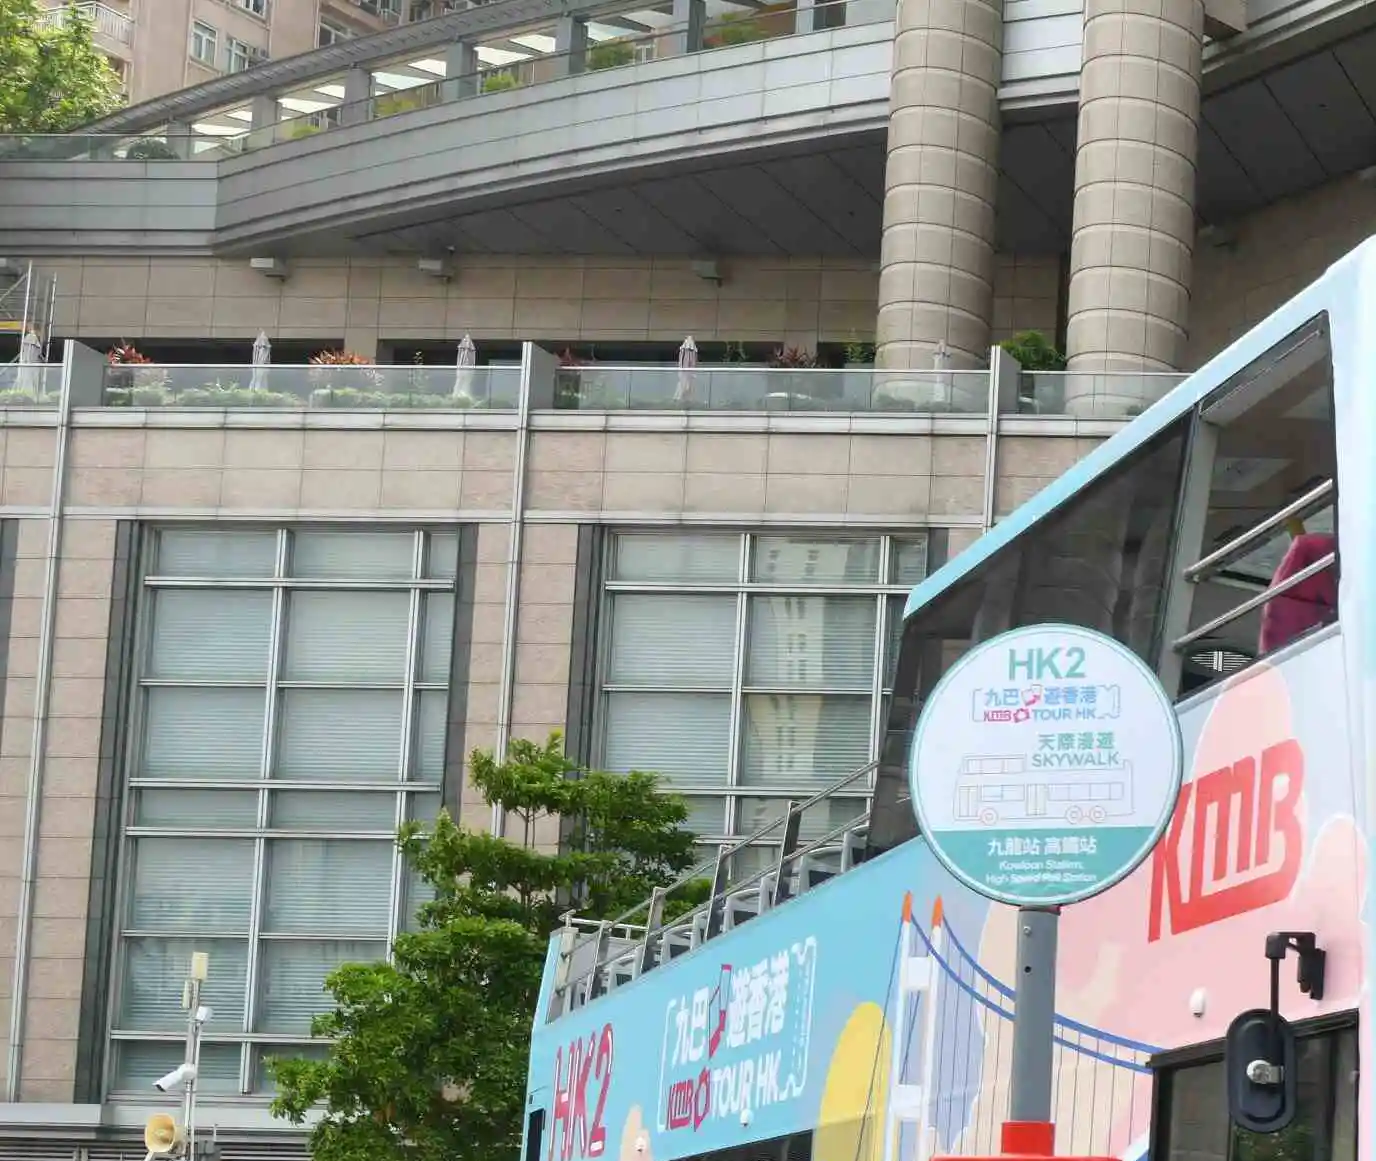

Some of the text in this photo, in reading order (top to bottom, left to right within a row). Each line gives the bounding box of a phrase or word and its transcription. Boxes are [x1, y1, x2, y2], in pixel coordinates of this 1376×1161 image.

[1008, 646, 1086, 681] HK2
[984, 687, 1019, 707] 九巴
[1032, 708, 1072, 721] TOUR
[1075, 707, 1097, 721] HK
[1031, 751, 1120, 768] SKYWALK
[1148, 738, 1305, 944] KMB
[672, 985, 710, 1070] 九巴
[666, 1048, 782, 1132] KMB TOUR HK
